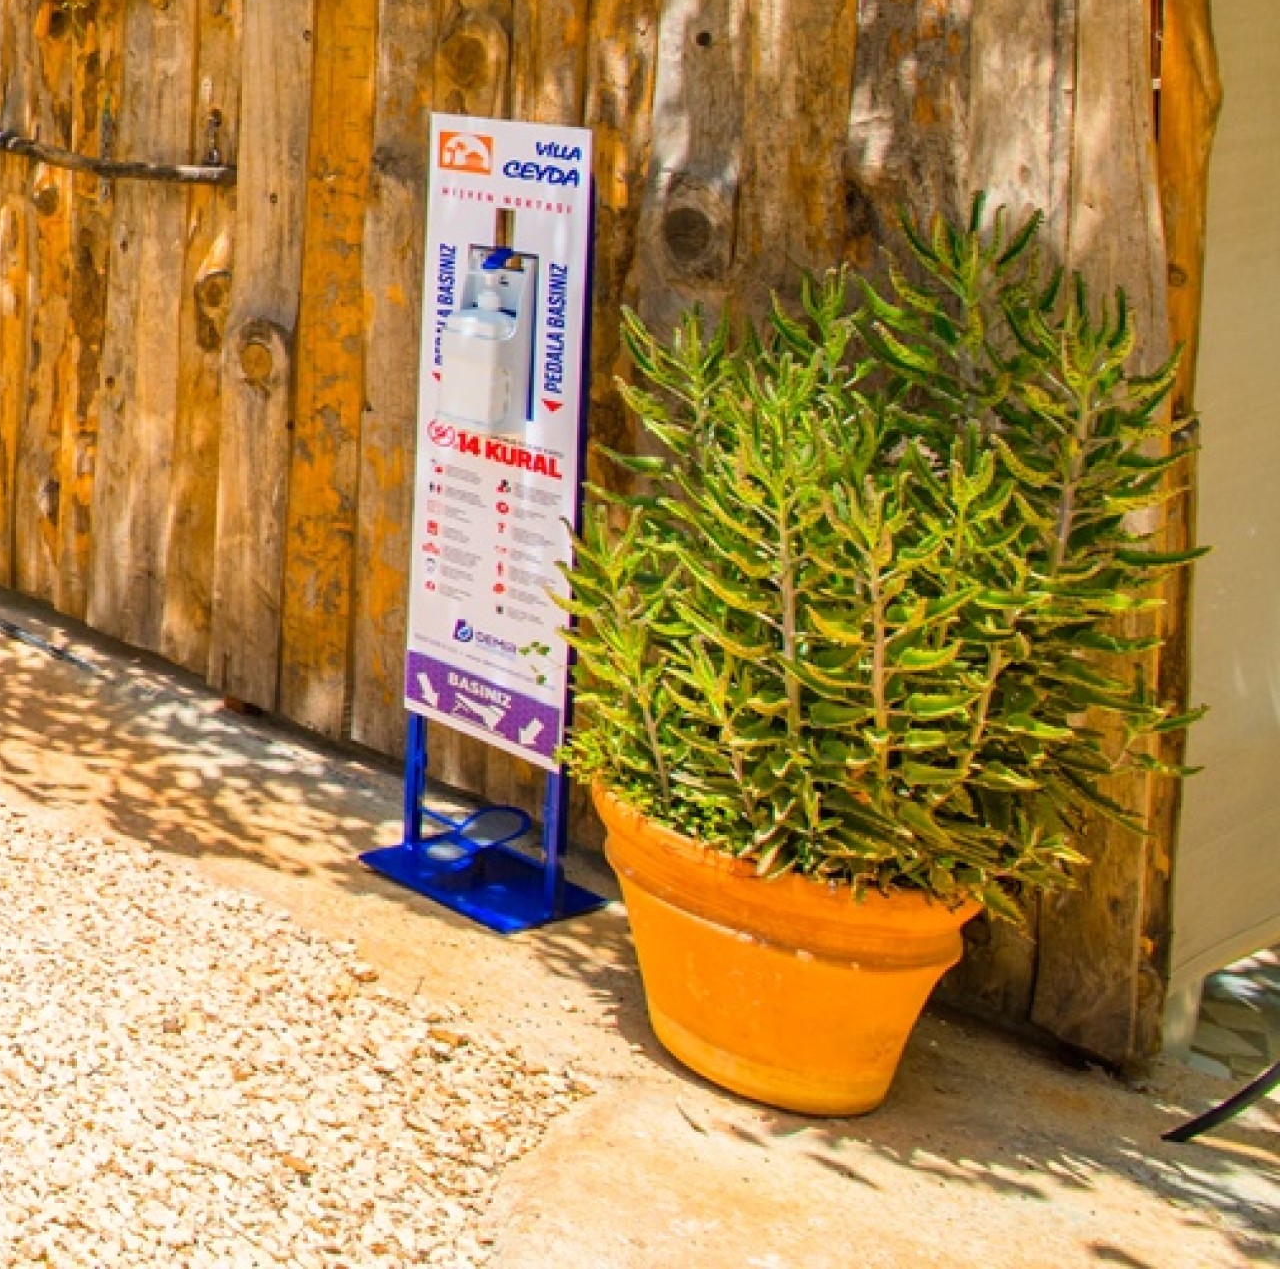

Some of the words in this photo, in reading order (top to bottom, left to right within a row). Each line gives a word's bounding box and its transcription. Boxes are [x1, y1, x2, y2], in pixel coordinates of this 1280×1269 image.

[503, 160, 580, 188] CEYDA
[437, 243, 456, 305] BASINIZ
[546, 263, 568, 329] BASINIZ
[543, 332, 565, 394] PEDALA
[458, 432, 481, 457] 14
[485, 439, 563, 480] KURAL
[447, 672, 512, 709] BASINIZ
